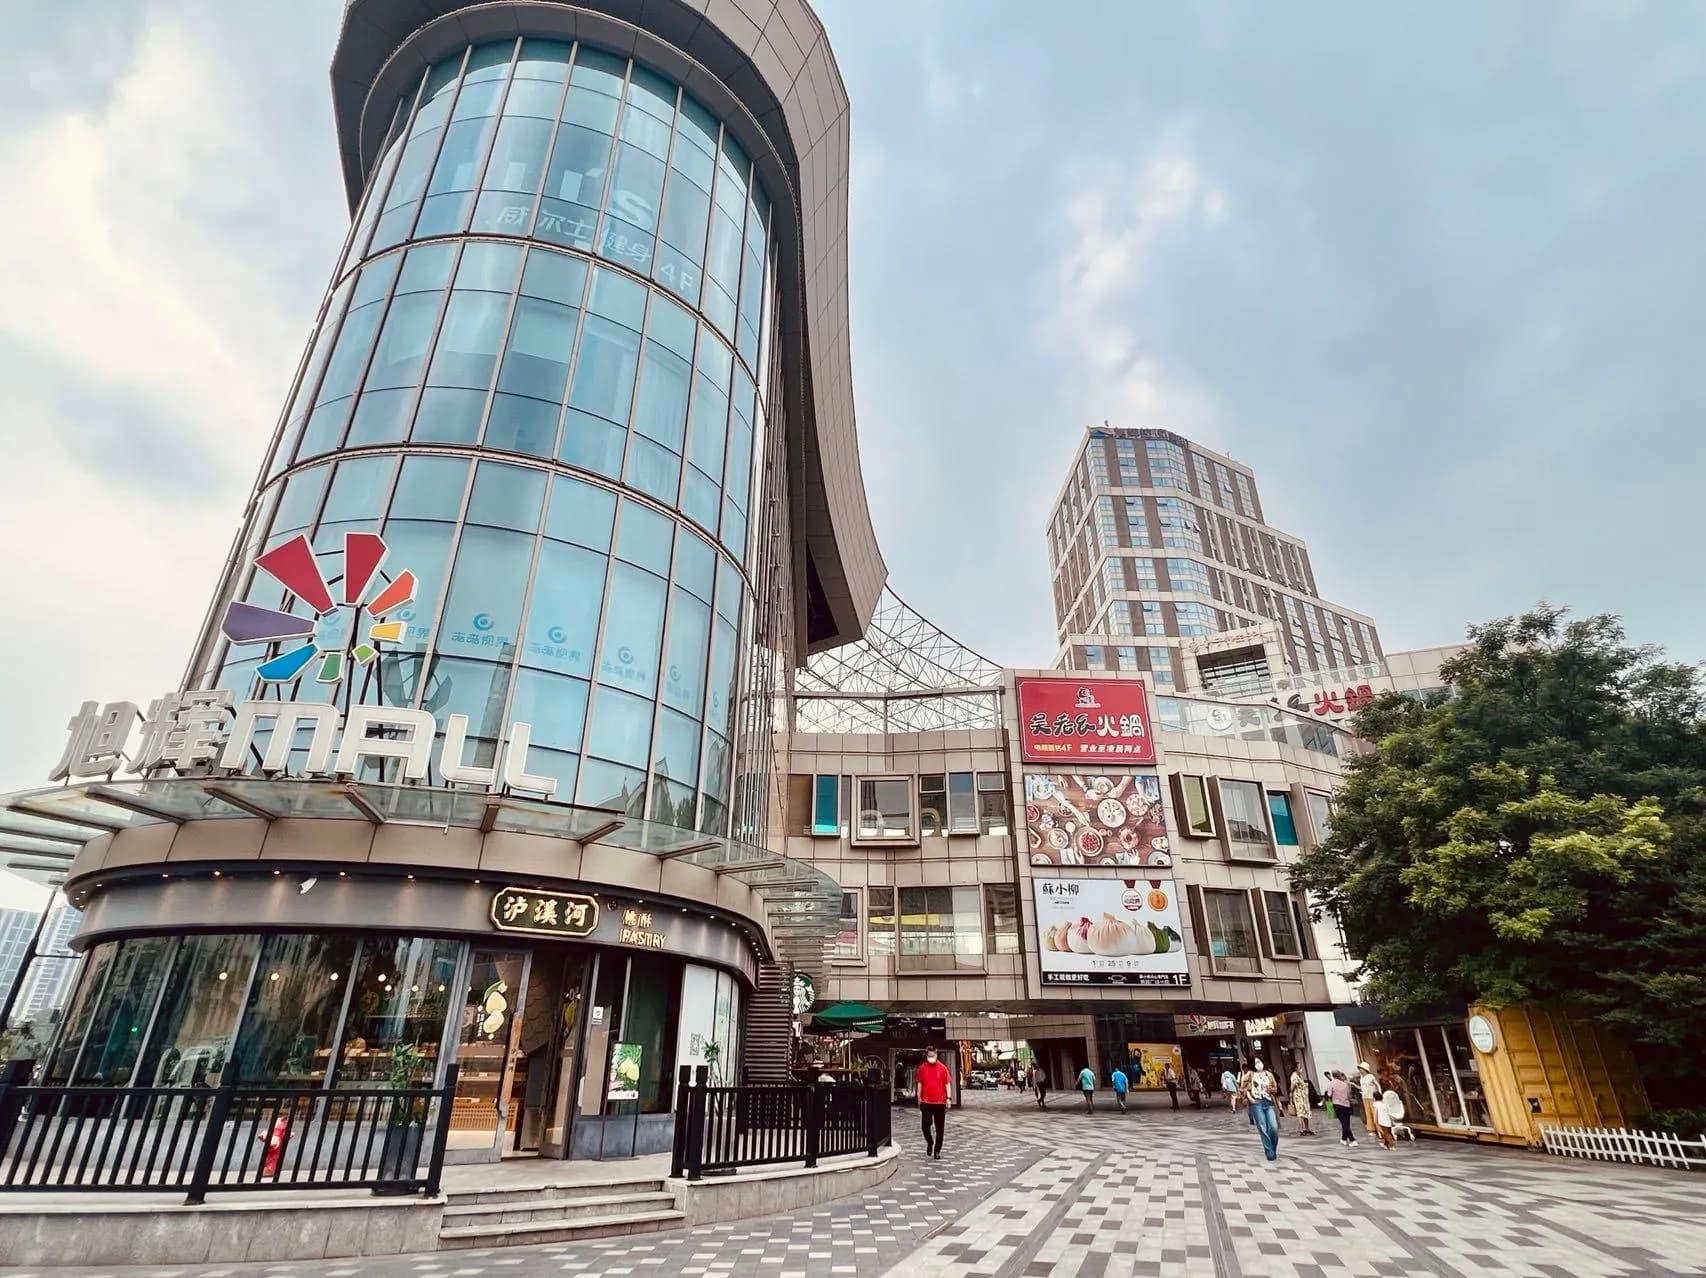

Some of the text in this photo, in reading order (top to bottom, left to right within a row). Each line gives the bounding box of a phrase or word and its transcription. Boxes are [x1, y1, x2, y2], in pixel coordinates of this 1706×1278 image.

[660, 263, 695, 292] 4F
[1042, 882, 1080, 896] 蘇小柳
[503, 895, 589, 927] 泸溪河
[620, 929, 667, 948] PASTRY
[1172, 973, 1187, 985] 1F
